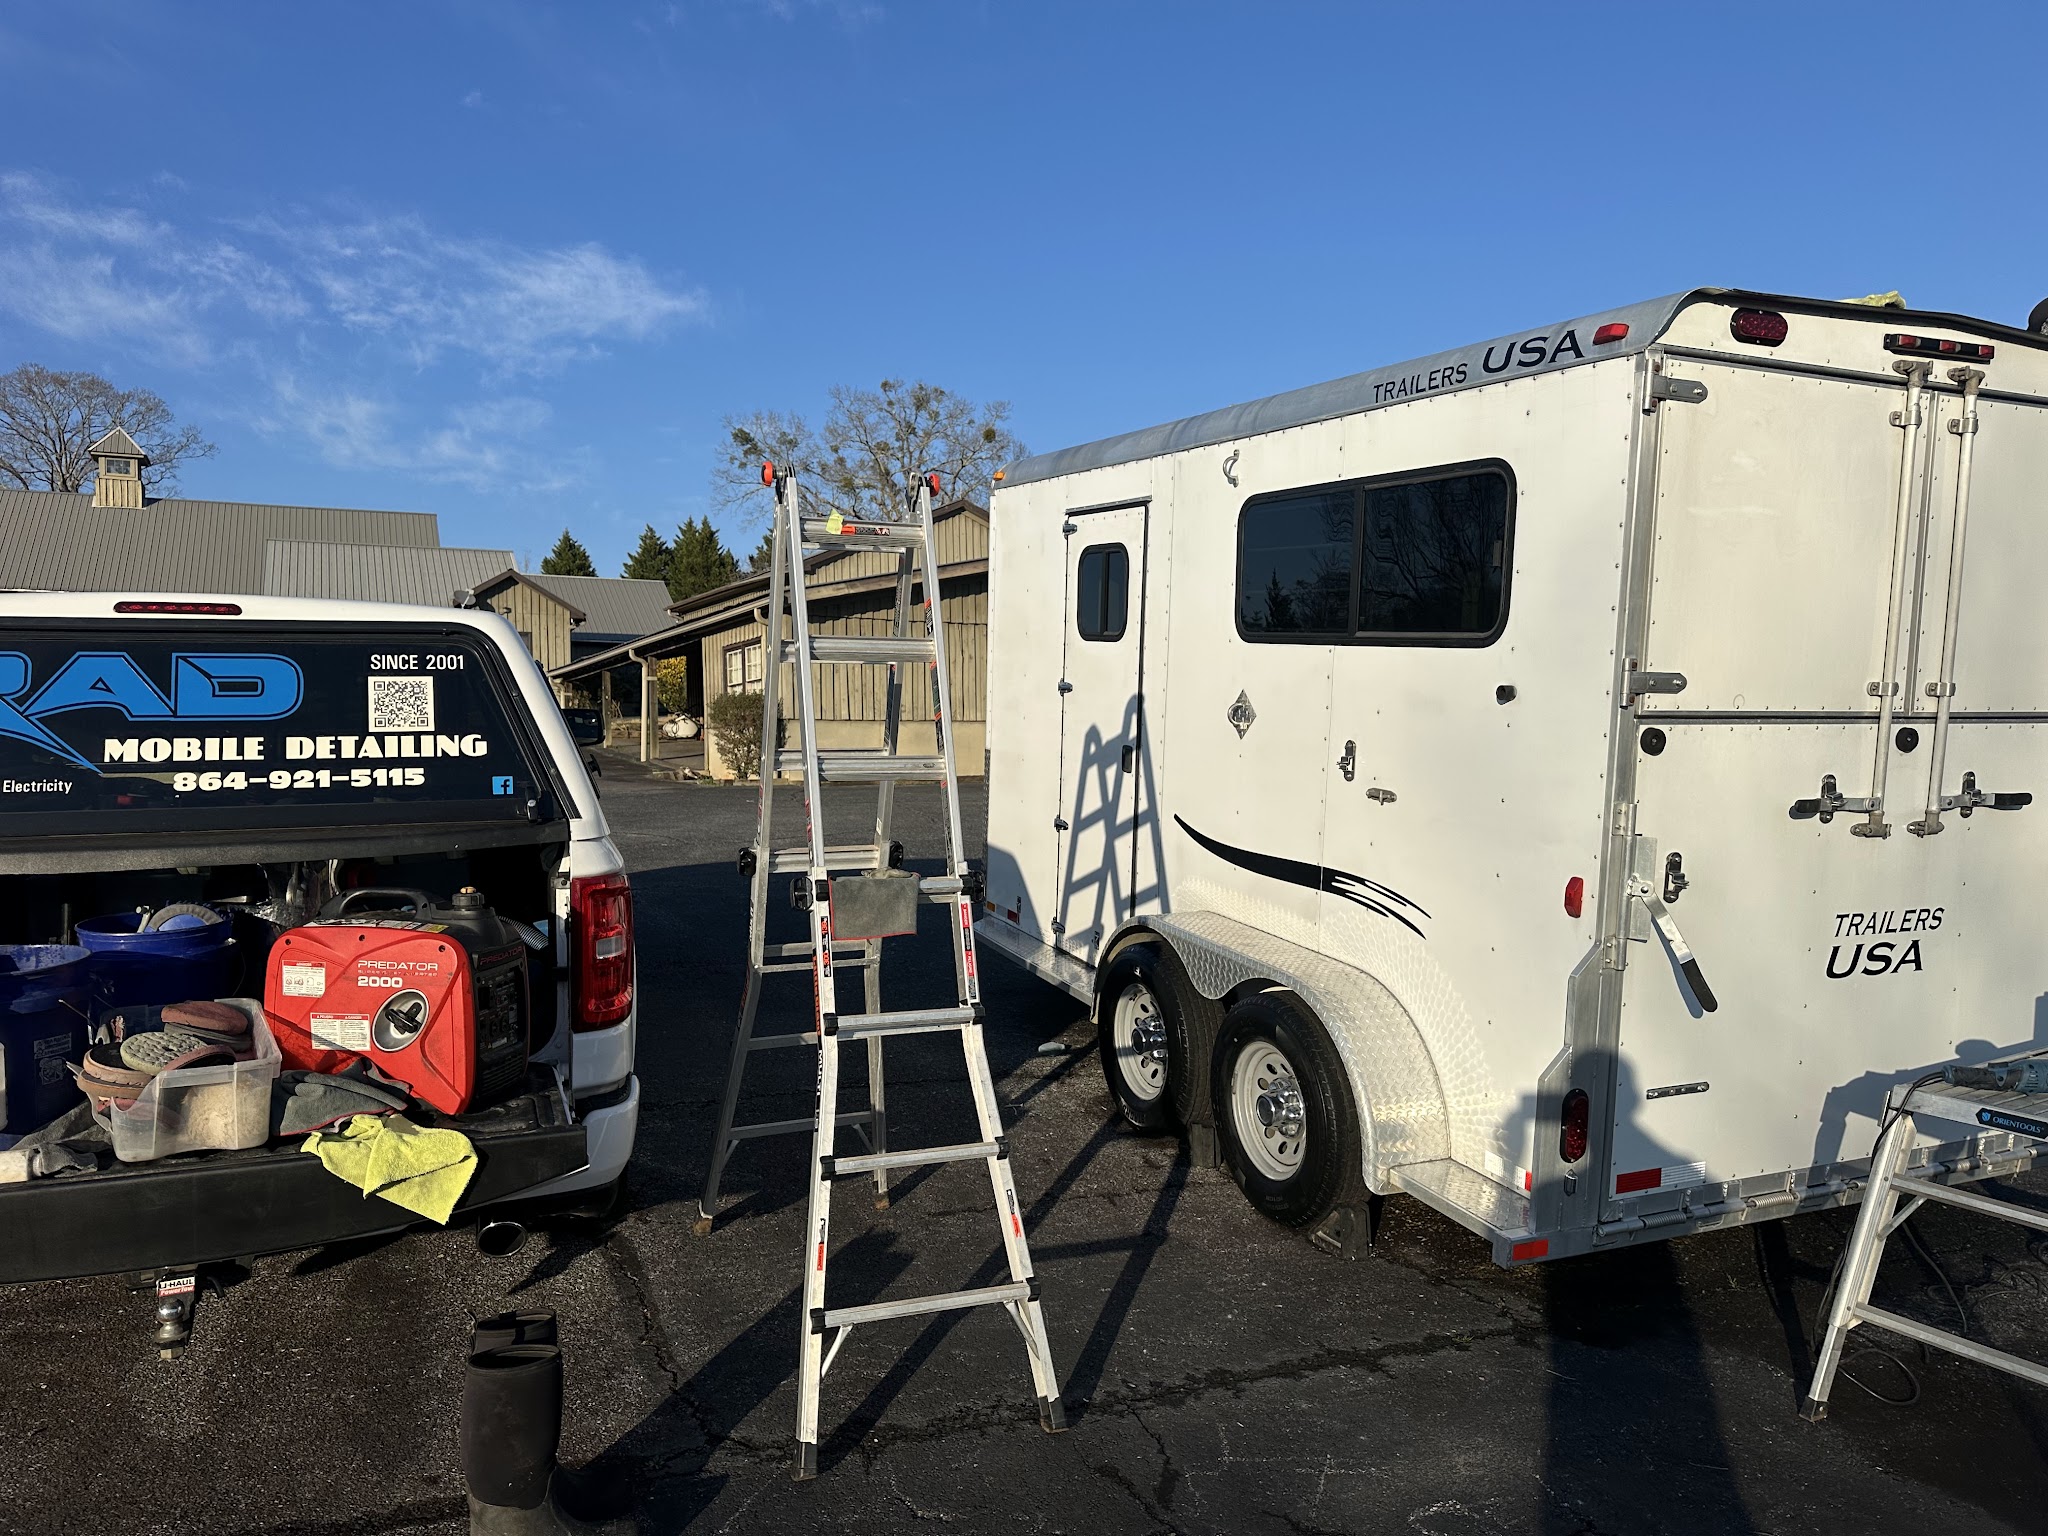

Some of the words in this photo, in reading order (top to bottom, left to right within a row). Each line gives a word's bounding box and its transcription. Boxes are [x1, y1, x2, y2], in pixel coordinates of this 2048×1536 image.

[1373, 362, 1469, 404] TRAILERS
[1482, 328, 1586, 374] USA
[370, 654, 419, 671] SINCE
[425, 654, 464, 671] 2001
[103, 736, 265, 763] MOBILE
[285, 733, 488, 760] DETAILING
[2, 779, 73, 795] Electricity
[172, 767, 426, 792] 864-921-5115
[1834, 906, 1946, 938] TRAILERS
[357, 960, 438, 971] PREDATOR
[1825, 938, 1923, 979] USA
[357, 976, 403, 988] 2000
[1992, 1116, 2041, 1134] ORIENTOOLS
